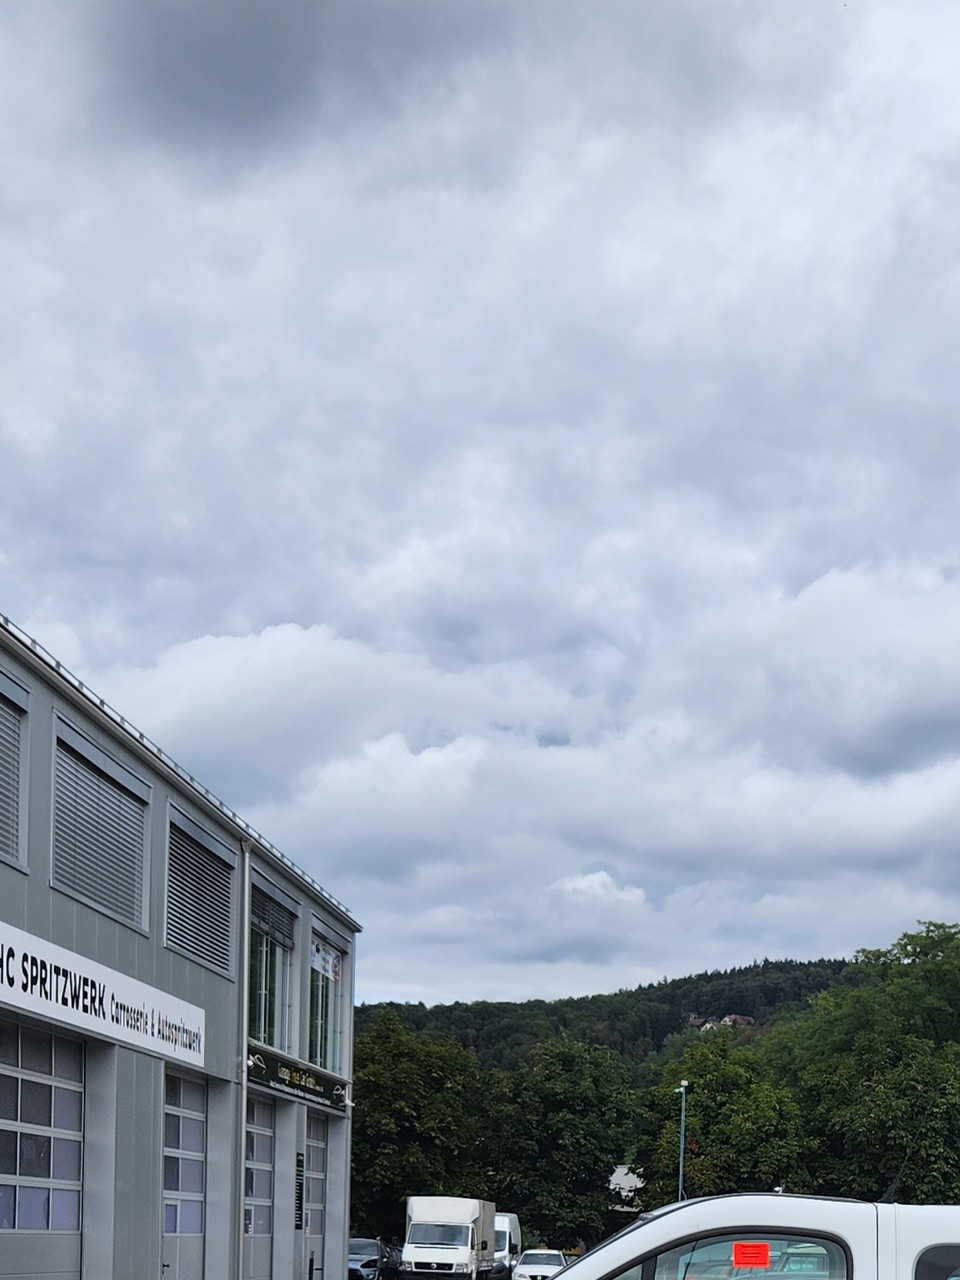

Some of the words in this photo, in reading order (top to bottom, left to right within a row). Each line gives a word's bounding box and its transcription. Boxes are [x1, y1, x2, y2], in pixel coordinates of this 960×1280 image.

[21, 952, 106, 1021] SPRITZWERK
[110, 992, 148, 1035] Carrosserie
[157, 1011, 202, 1055] Autospritzwerk
